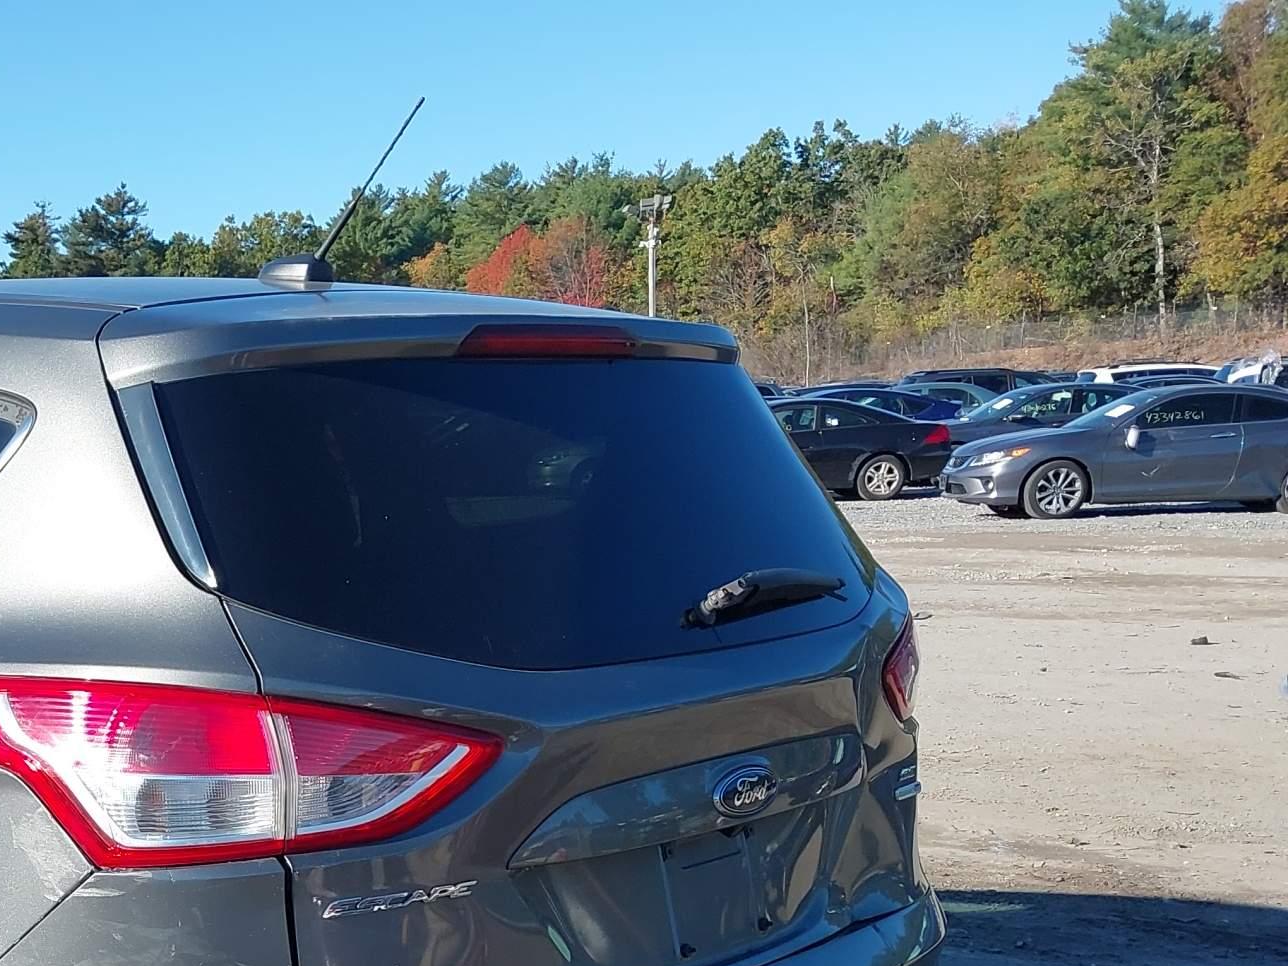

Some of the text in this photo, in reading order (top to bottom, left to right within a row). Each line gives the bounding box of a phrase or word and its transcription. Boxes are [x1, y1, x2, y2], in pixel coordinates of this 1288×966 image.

[1145, 410, 1204, 424] 43342861
[734, 775, 771, 808] Ford
[322, 879, 478, 919] ESCAPE
